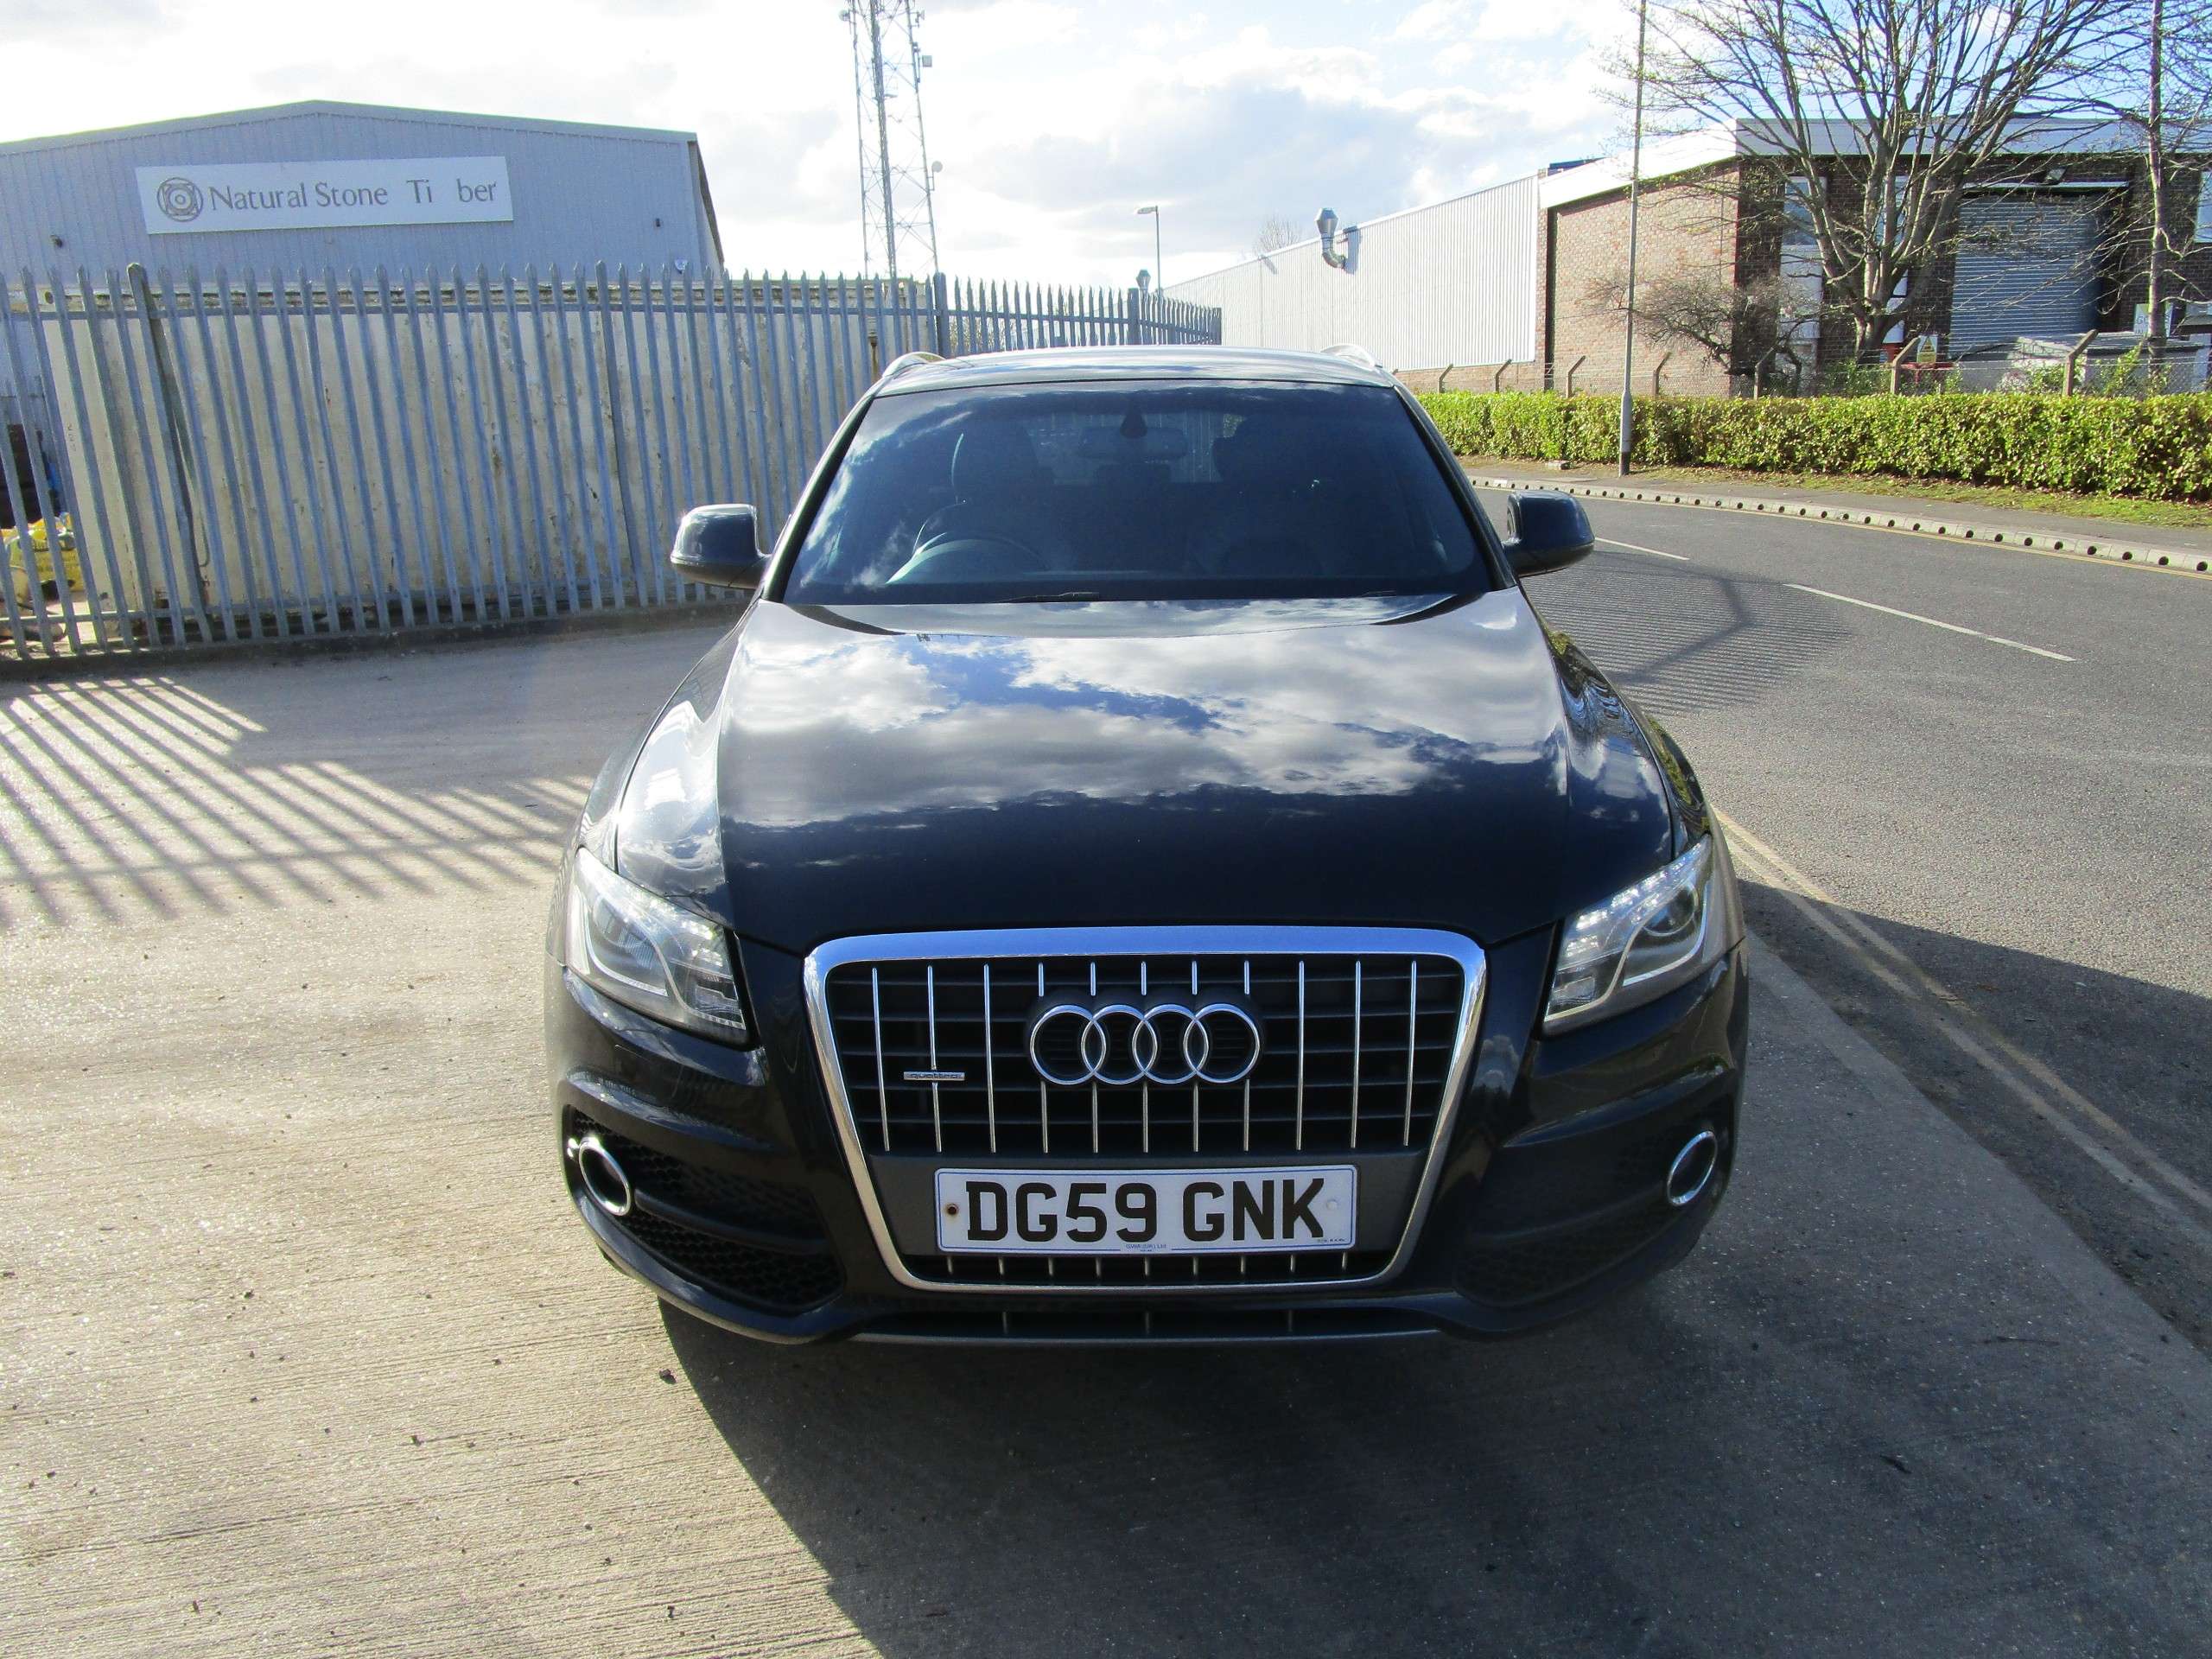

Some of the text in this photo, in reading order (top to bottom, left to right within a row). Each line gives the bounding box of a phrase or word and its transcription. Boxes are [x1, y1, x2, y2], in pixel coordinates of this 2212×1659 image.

[208, 182, 308, 210] Natural
[315, 181, 388, 207] Stone
[966, 1179, 1325, 1243] DG59 GNK
